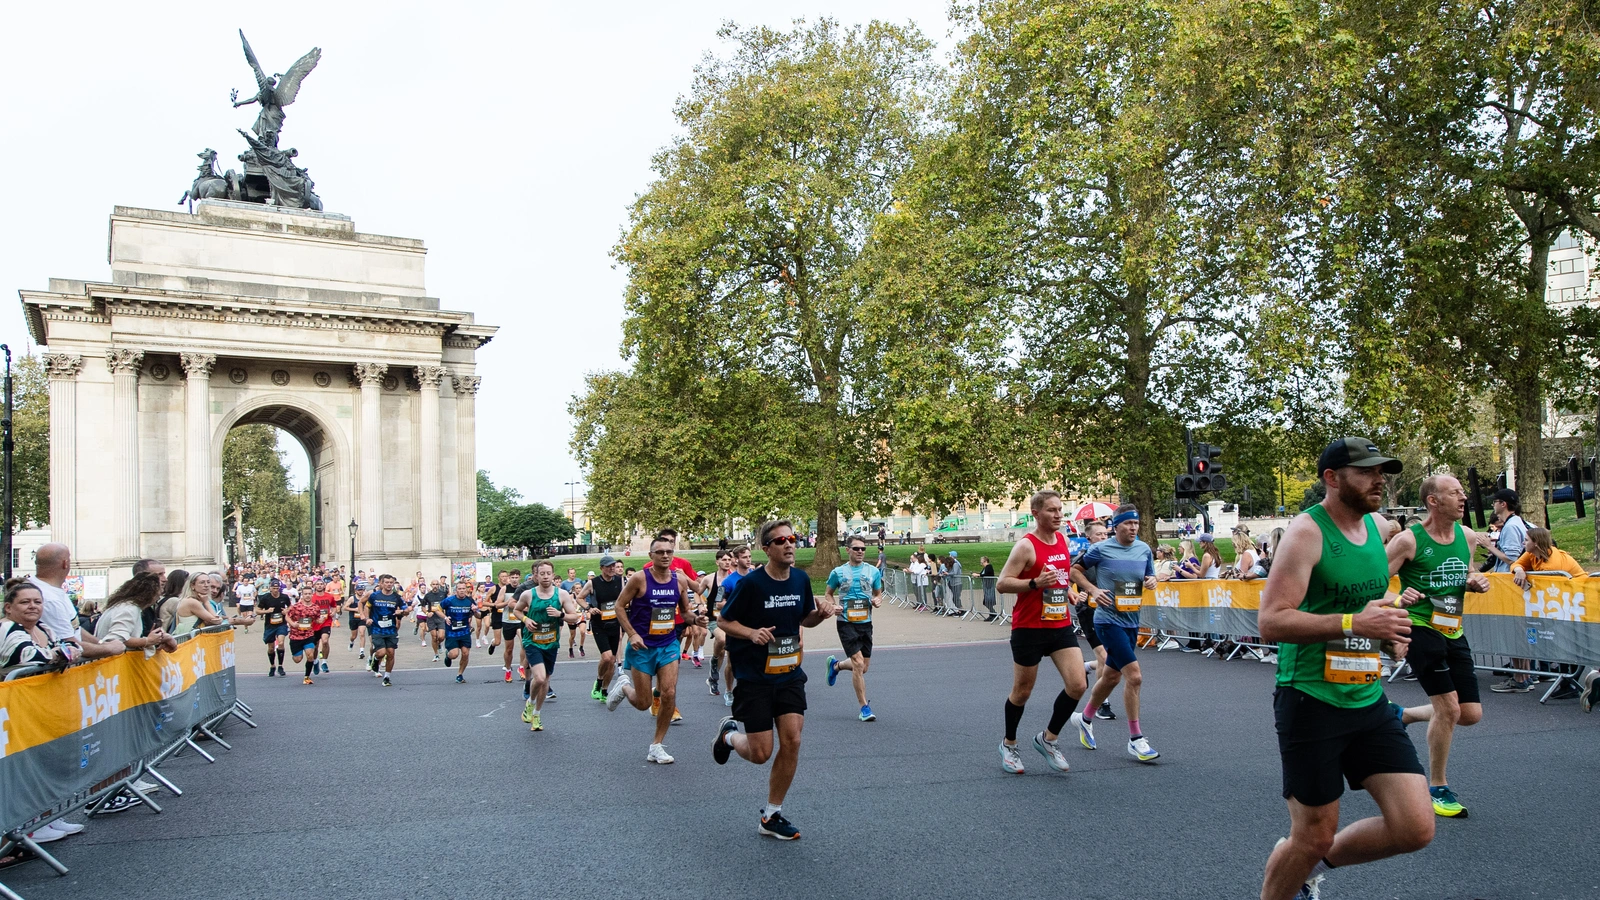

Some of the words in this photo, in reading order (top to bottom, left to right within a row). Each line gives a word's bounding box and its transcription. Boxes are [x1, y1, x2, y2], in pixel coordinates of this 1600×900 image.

[1047, 553, 1067, 562] JAKUB
[1442, 573, 1467, 581] ROGUE
[1323, 577, 1385, 597] HARWELL
[1051, 595, 1065, 603] 1323
[775, 600, 796, 608] Harriers
[1523, 590, 1586, 621] Half
[1344, 637, 1372, 650] 1526
[777, 645, 794, 654] 1836
[78, 675, 120, 730] Half
